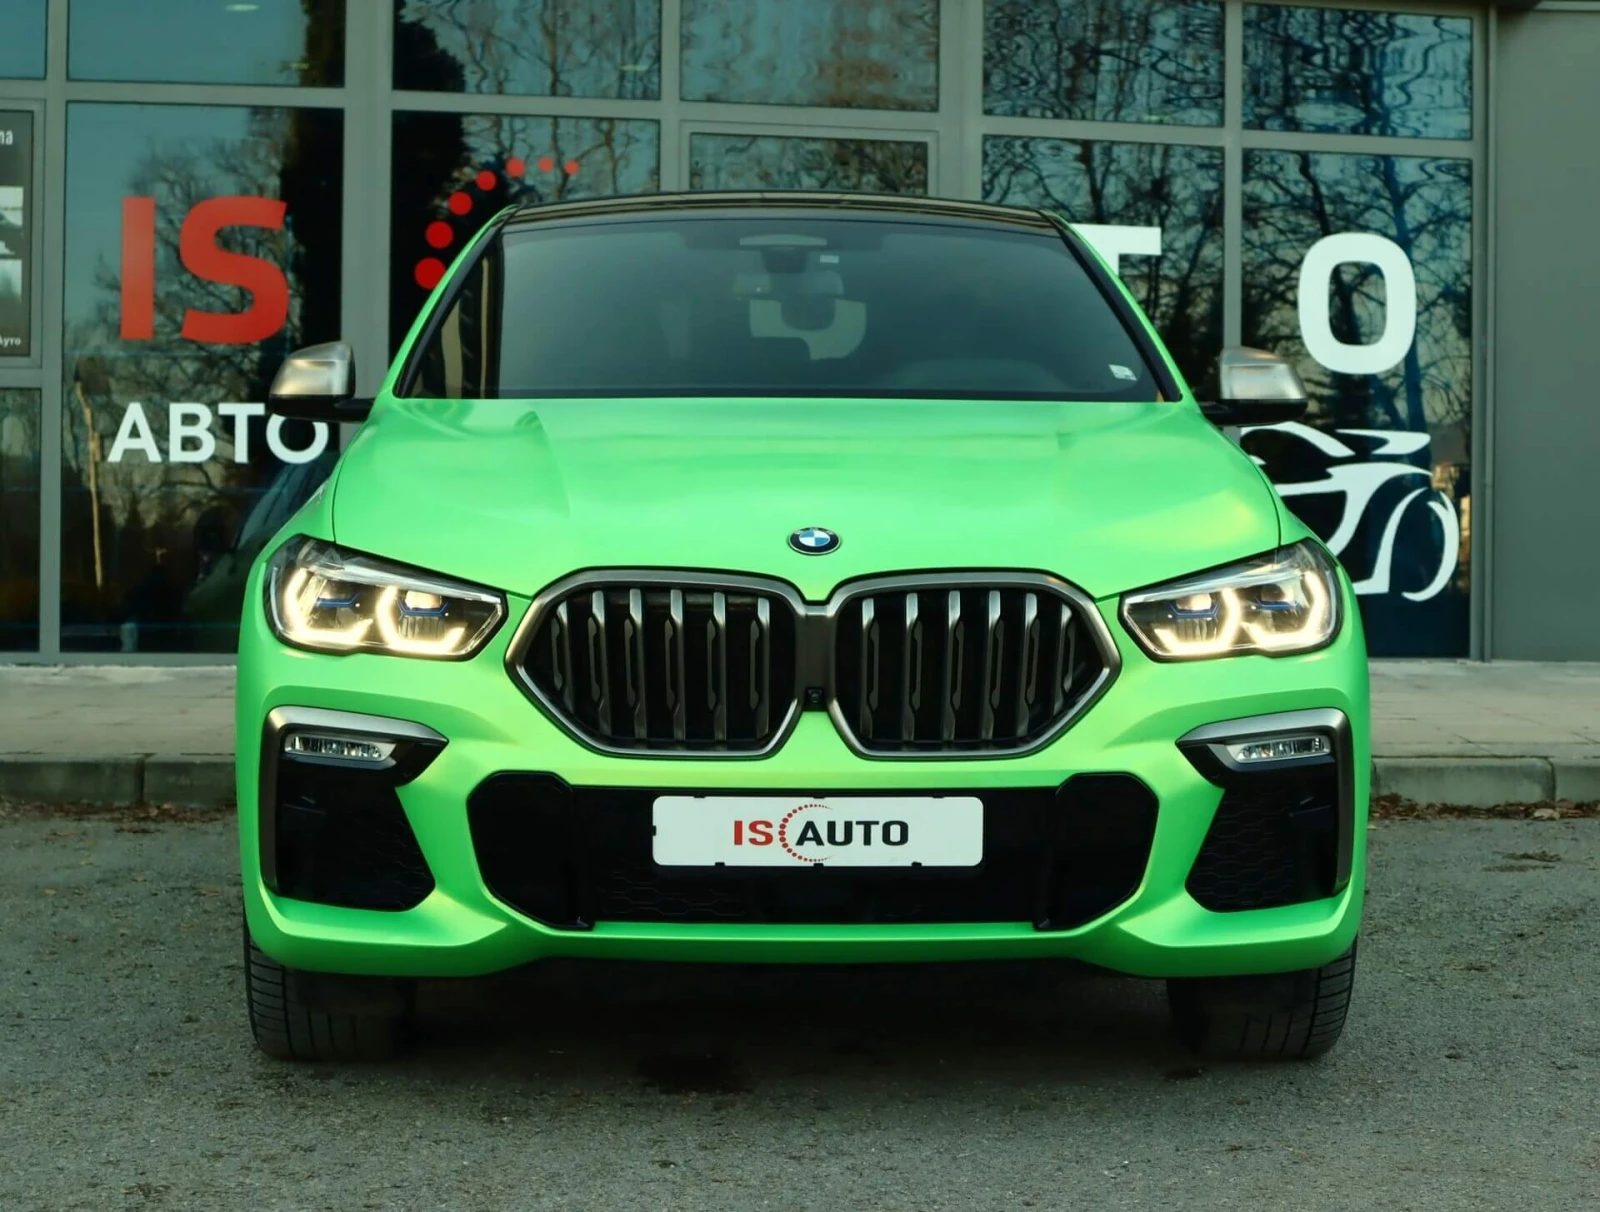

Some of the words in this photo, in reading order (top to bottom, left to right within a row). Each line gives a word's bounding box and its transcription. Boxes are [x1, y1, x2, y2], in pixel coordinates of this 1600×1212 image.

[120, 195, 289, 344] IS
[733, 820, 774, 846] IS
[795, 820, 909, 847] AUTO
